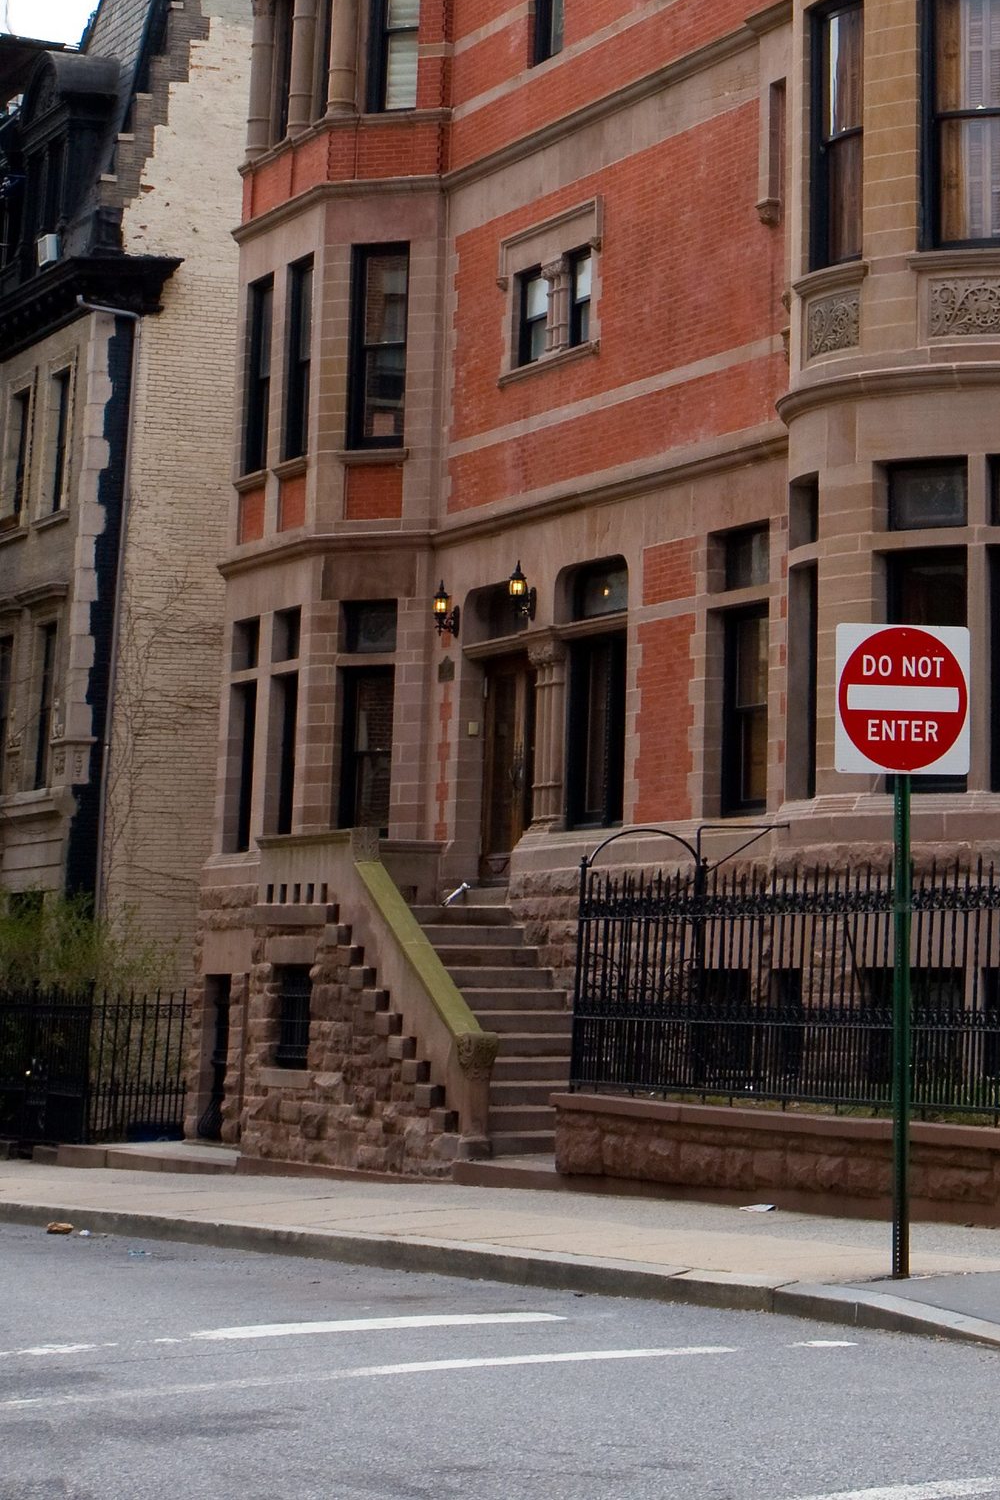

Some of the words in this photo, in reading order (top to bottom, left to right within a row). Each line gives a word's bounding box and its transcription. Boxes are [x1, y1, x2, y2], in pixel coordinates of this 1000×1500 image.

[862, 654, 893, 677] DO
[902, 655, 945, 678] NOT
[867, 719, 938, 743] ENTER
